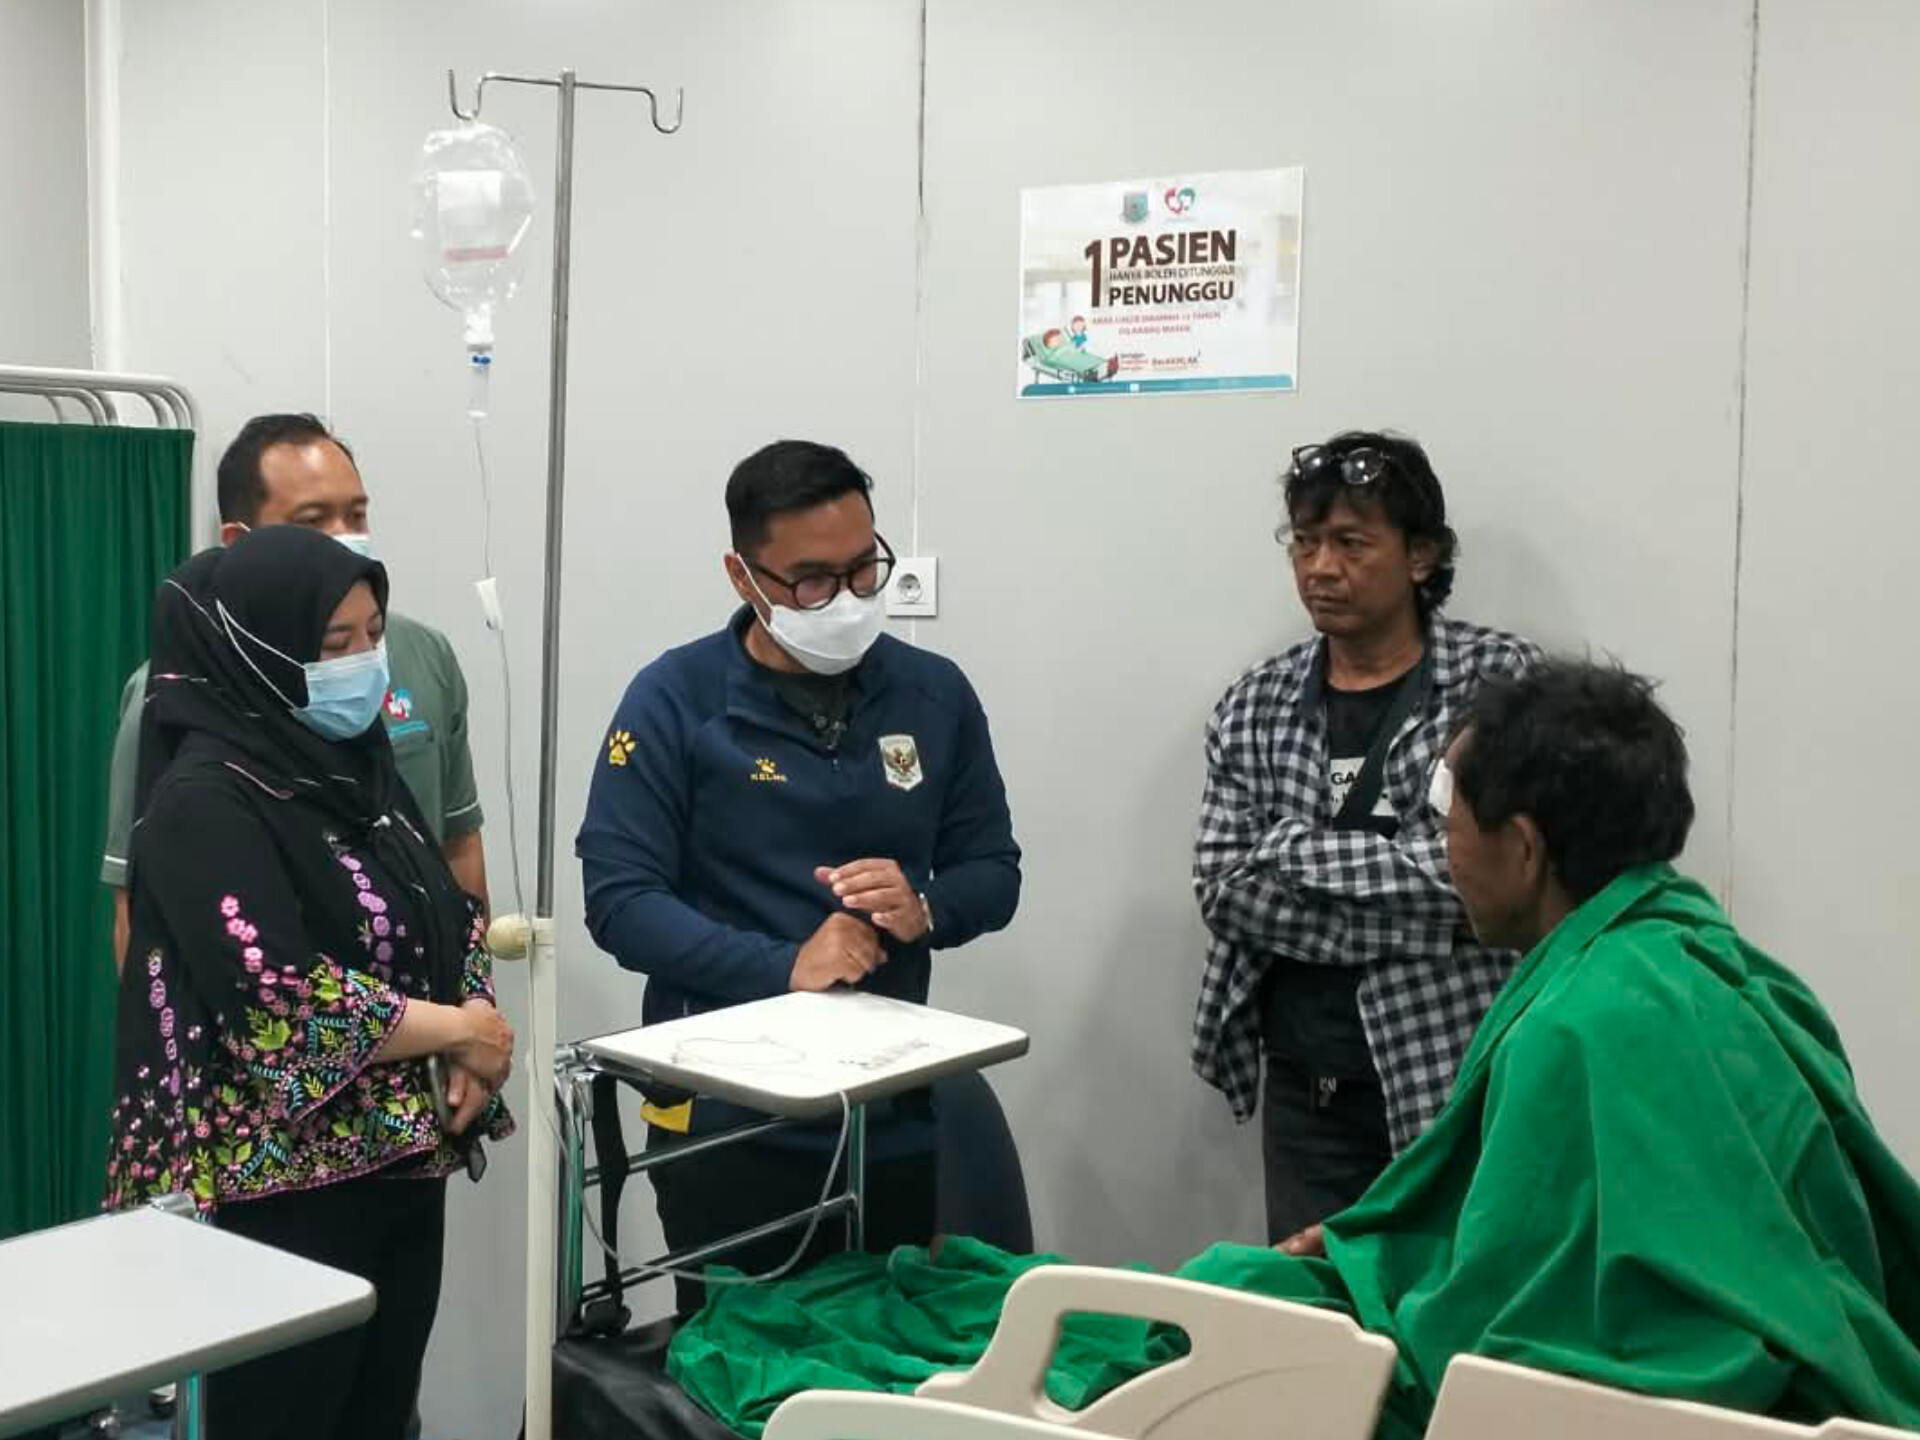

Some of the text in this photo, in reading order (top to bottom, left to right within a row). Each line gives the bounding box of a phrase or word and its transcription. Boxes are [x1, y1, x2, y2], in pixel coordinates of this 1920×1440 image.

[1085, 229, 1236, 308] 1 PASIEN
[1144, 268, 1177, 279] BOLEH
[1109, 280, 1234, 307] PENUNGGU
